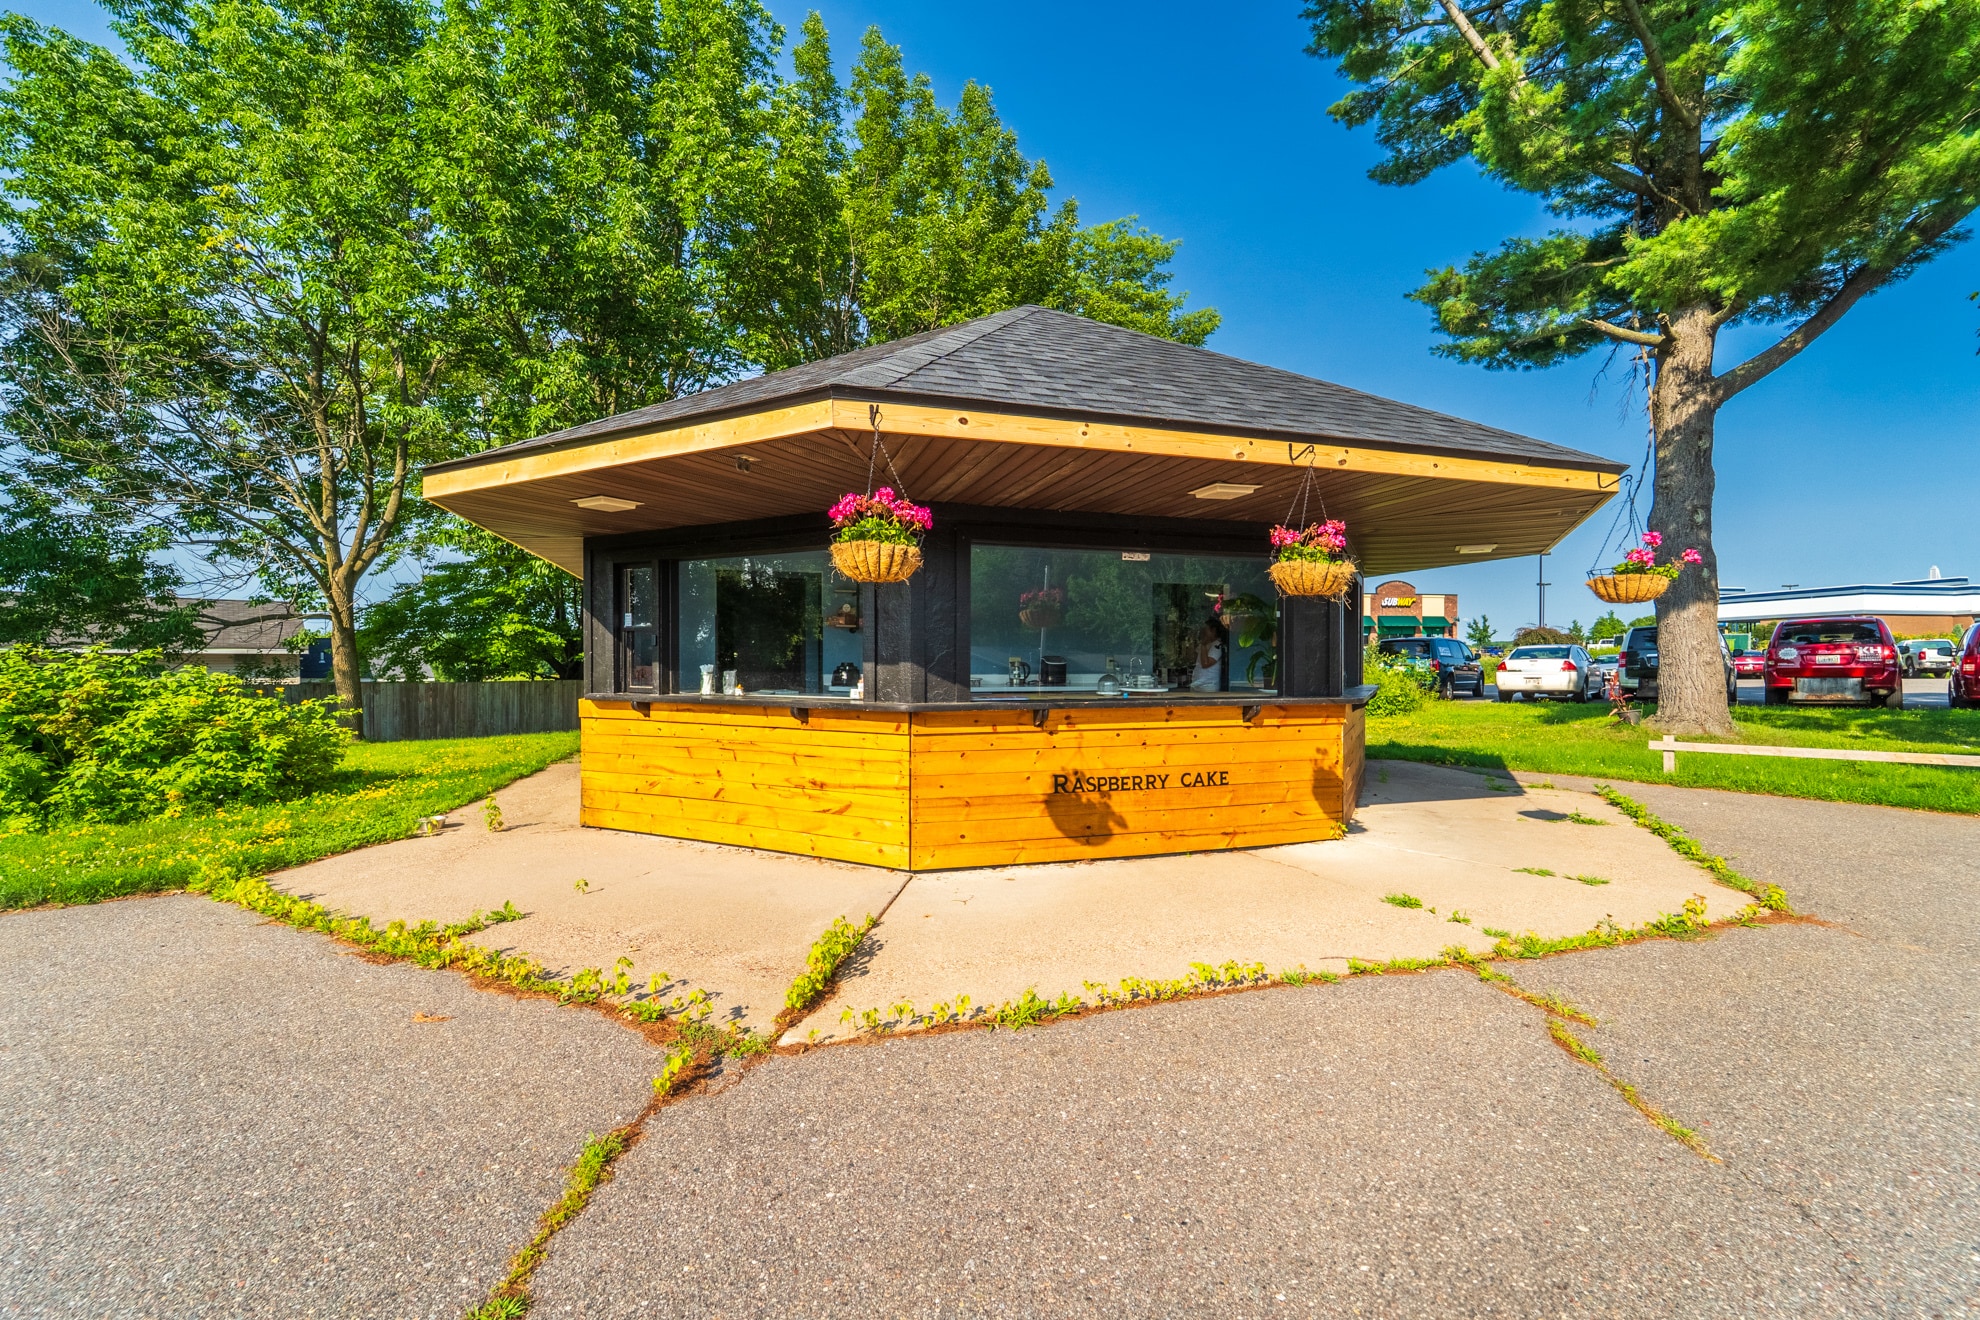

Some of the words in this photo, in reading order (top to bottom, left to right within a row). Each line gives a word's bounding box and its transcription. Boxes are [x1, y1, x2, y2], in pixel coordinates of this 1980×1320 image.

[1381, 597, 1416, 607] SUBWAY
[1052, 774, 1170, 794] RASPBERRY
[1180, 771, 1229, 787] CAKE
